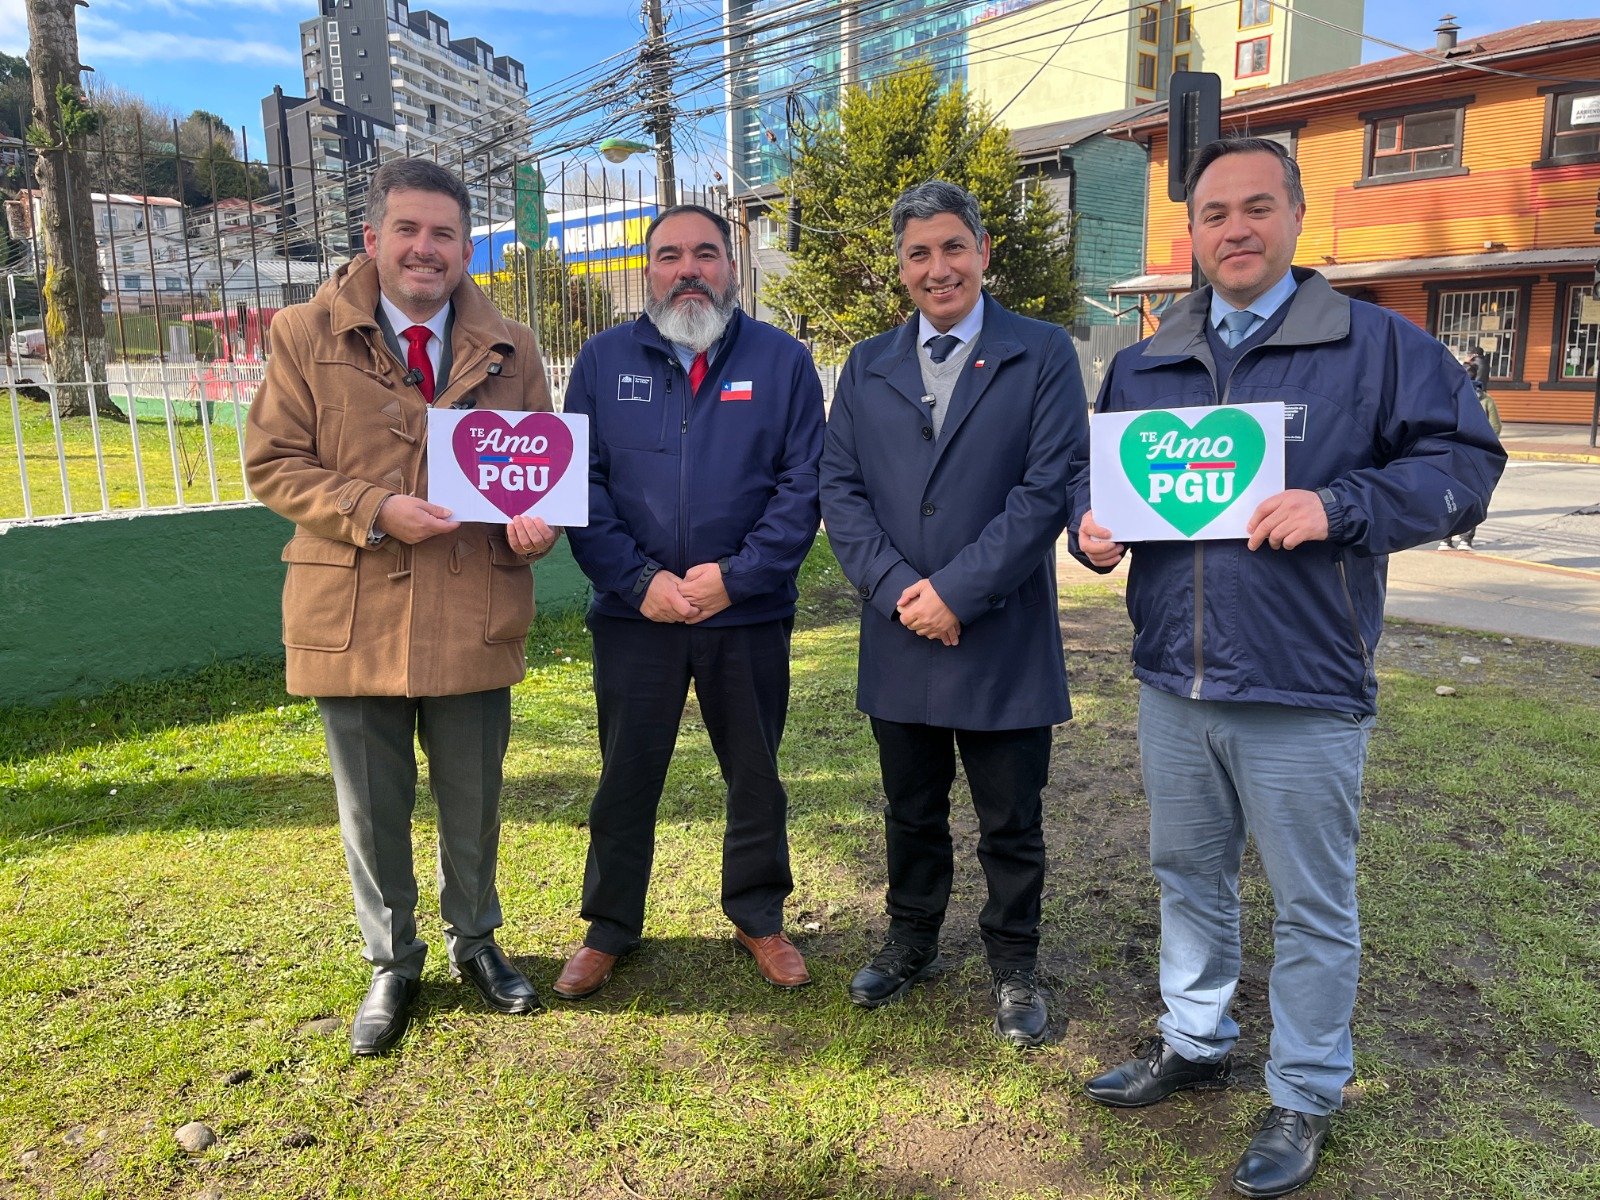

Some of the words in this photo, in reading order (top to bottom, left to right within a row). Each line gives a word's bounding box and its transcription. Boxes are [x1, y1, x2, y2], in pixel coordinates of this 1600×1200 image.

[469, 427, 485, 437] TE
[475, 428, 548, 454] Amo
[1140, 431, 1157, 442] TE
[1146, 430, 1234, 460] Amo
[478, 464, 550, 492] PGU
[1148, 472, 1235, 503] PGU
